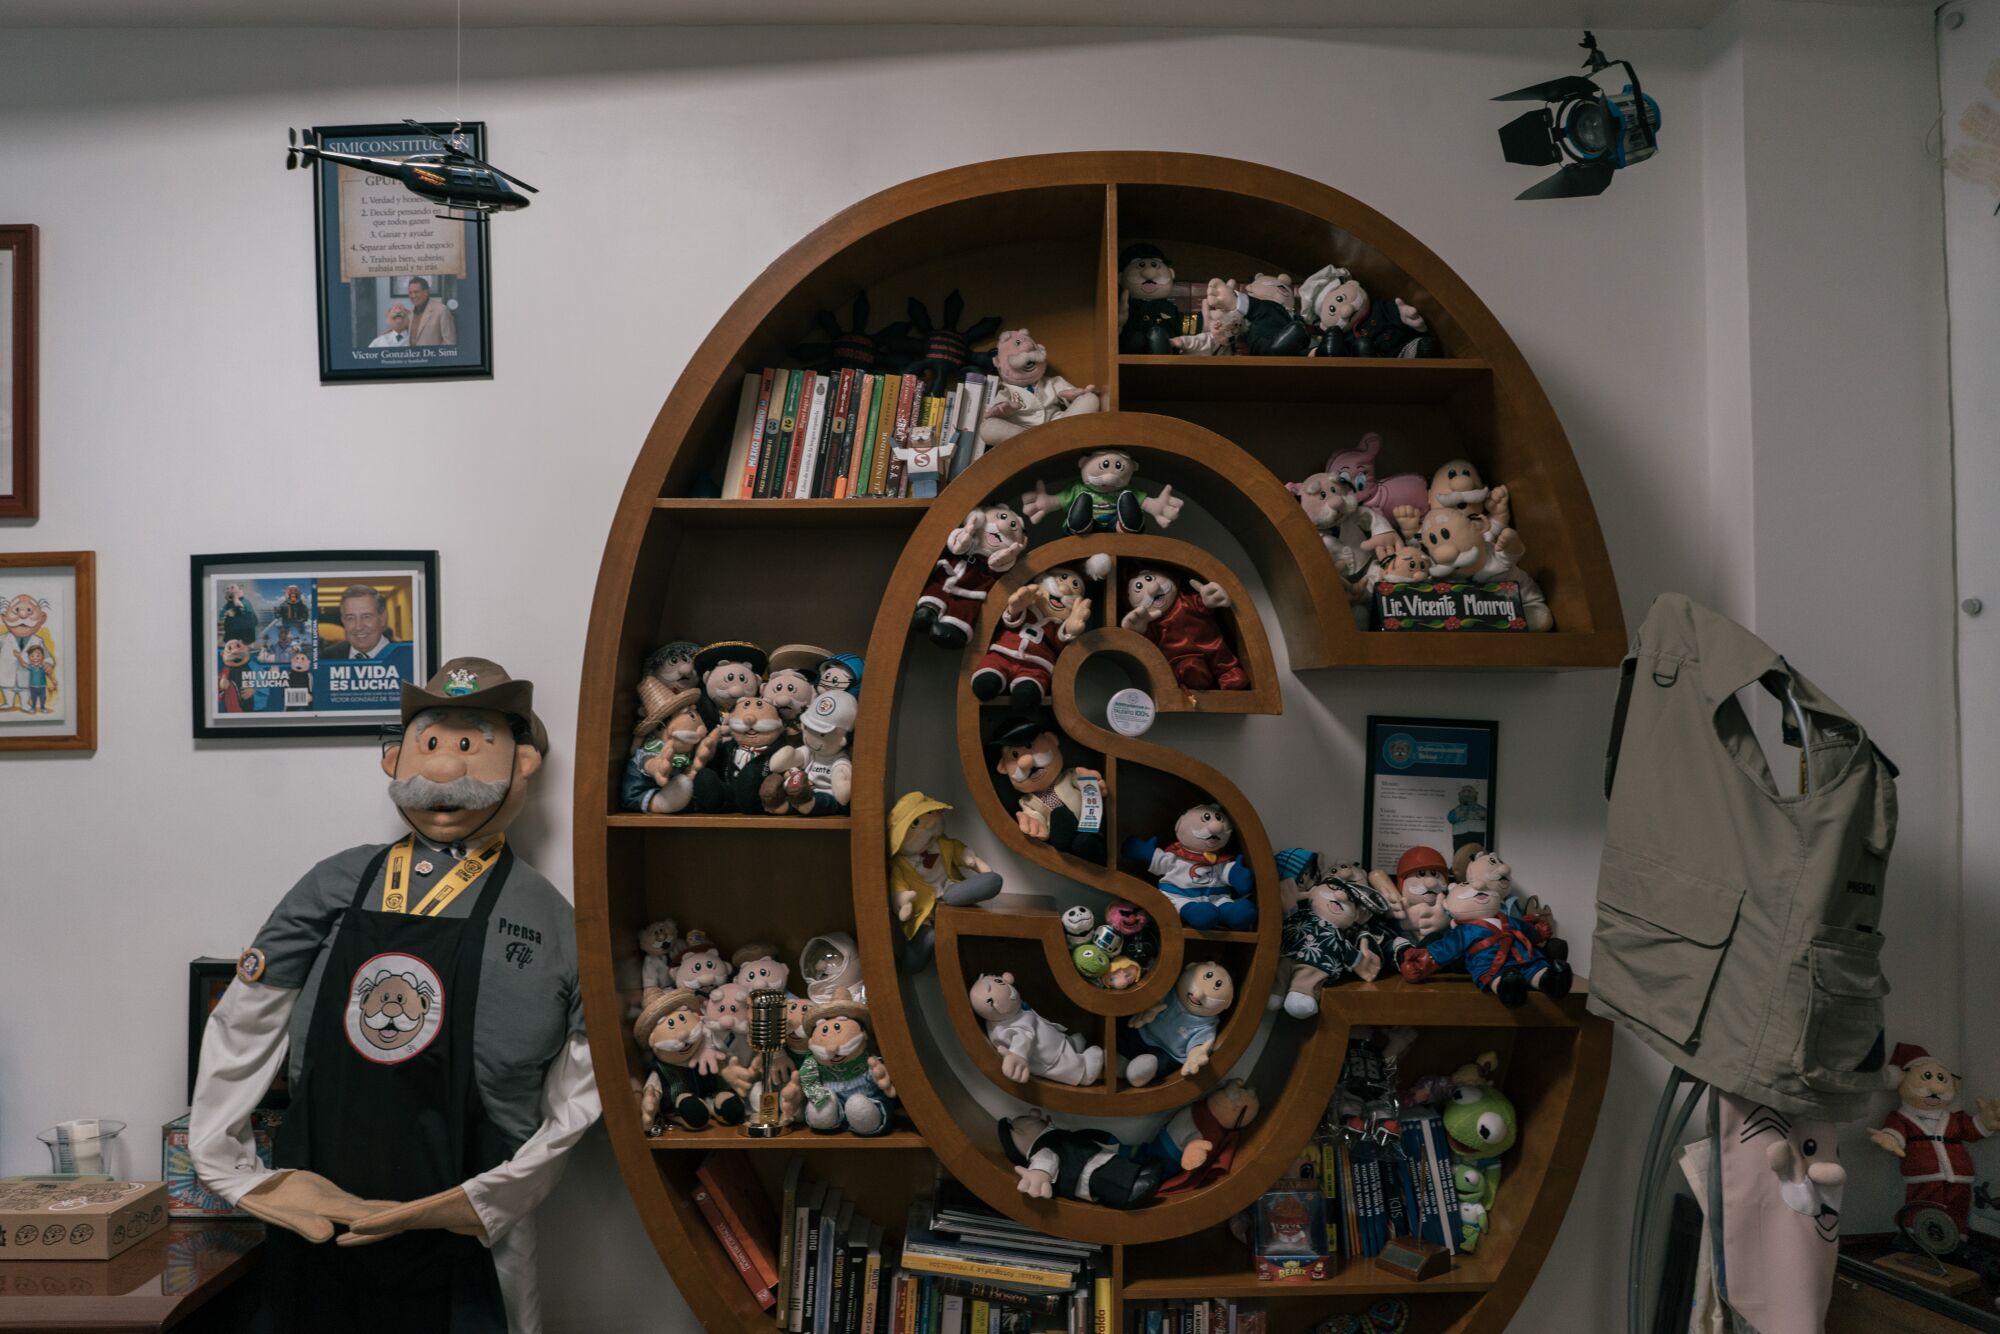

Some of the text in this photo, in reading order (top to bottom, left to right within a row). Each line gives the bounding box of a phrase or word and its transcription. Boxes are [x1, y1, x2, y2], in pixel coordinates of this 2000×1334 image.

[329, 137, 470, 153] SIMICONSTITUCN
[370, 196, 396, 205] Verdad
[396, 198, 401, 206] y
[370, 208, 397, 217] Decidir
[398, 208, 431, 218] pensando
[373, 219, 386, 228] que
[388, 217, 408, 226] todos
[379, 230, 401, 238] Ganar
[402, 231, 407, 239] y
[409, 229, 434, 239] ayudar
[360, 243, 387, 252] Separar
[414, 241, 425, 249] del
[427, 241, 455, 251] negocio
[381, 348, 421, 360] González
[423, 349, 437, 358] Dr.
[439, 348, 458, 357] Simi
[838, 375, 850, 413] PATRIA
[874, 432, 888, 490] EL INQUISIDOR
[1382, 594, 1516, 622] Lic. Vicente Monroy
[241, 670, 290, 680] MI VIDA
[330, 665, 400, 679] MI VIDA
[242, 680, 255, 688] ES
[330, 679, 400, 691] ES LUCHA
[499, 917, 542, 944] Prensa
[1353, 1163, 1361, 1183] LUCHA
[1425, 1162, 1434, 1182] LUCHA
[1439, 1159, 1447, 1179] LUCHA
[1444, 1159, 1453, 1178] LUCHA
[1447, 1204, 1452, 1212] MI
[1453, 1203, 1458, 1211] MI
